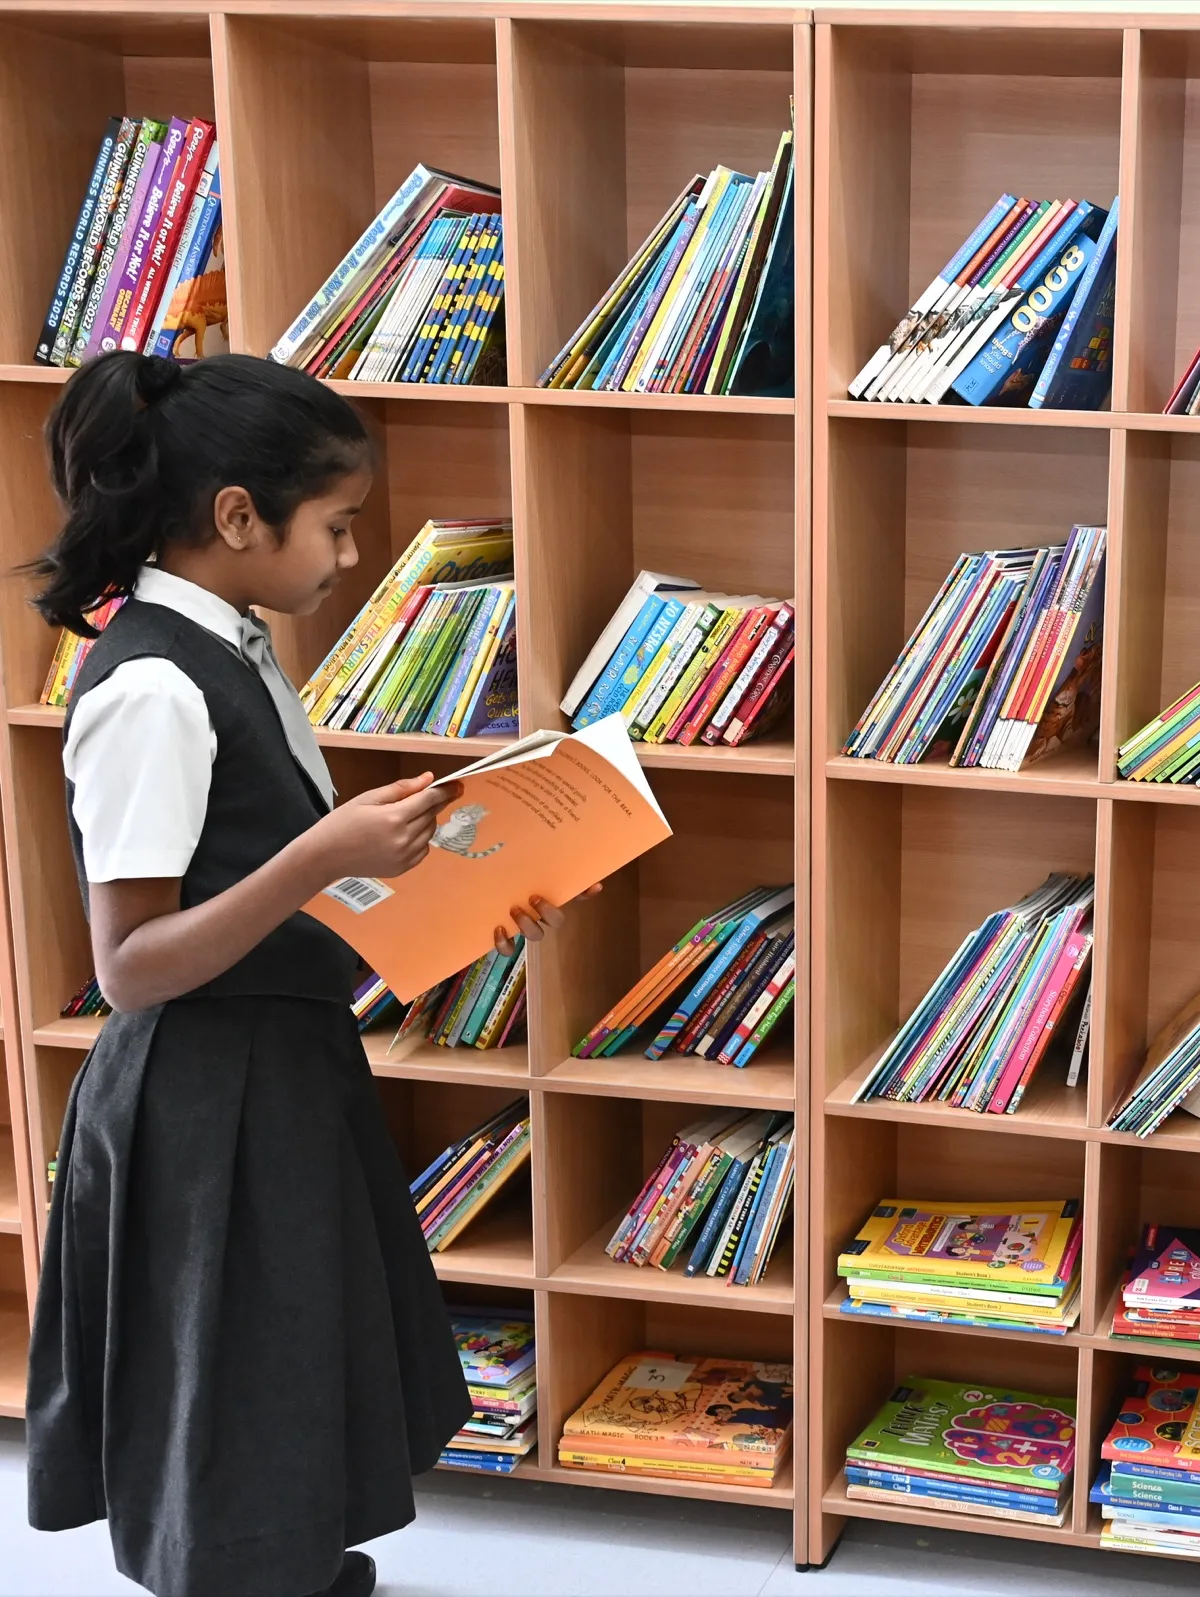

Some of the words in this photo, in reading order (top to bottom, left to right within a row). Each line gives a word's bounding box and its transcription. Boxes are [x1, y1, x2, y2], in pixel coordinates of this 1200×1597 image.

[87, 136, 113, 196] GUINNESS
[101, 141, 127, 200] GUINNESS
[119, 141, 147, 202] GUINNESS
[142, 185, 164, 228] Believe
[165, 179, 186, 218] Believe
[73, 197, 94, 242] WORLD
[87, 199, 109, 246] WORLD
[106, 201, 128, 245] WORLD
[161, 217, 174, 230] It
[181, 203, 200, 240] Science
[137, 227, 151, 240] It
[157, 228, 169, 241] or
[133, 239, 146, 253] or
[149, 240, 167, 266] Not!
[171, 238, 188, 270] Starter
[56, 241, 80, 297] RECORDS
[70, 245, 95, 301] RECORDS
[89, 245, 114, 301] RECORDS
[124, 253, 143, 281] Not!
[146, 266, 156, 279] ALL
[1085, 255, 1100, 277] Maths
[138, 280, 151, 304] WEIRD!
[1010, 243, 1087, 334] 8000
[1071, 275, 1091, 309] Dictionary
[46, 298, 63, 328] 2020
[62, 298, 79, 328] 2021
[107, 287, 126, 328] ORDINARY
[117, 288, 132, 317] ESCAPE
[134, 303, 144, 316] ALL
[81, 300, 98, 329] 2022
[113, 317, 123, 332] THE
[128, 316, 140, 336] TRUE!
[987, 345, 1003, 361] you
[988, 335, 1016, 359] things
[976, 357, 997, 375] know
[980, 351, 1003, 370] should
[397, 548, 434, 594] OXFORD
[377, 591, 404, 624] FIRST
[662, 599, 680, 618] JO
[666, 625, 681, 642] Bond
[335, 621, 383, 682] THESAURUS
[732, 923, 752, 944] Oxford
[769, 937, 784, 952] Kate
[721, 940, 739, 958] Study
[709, 954, 729, 975] Science
[750, 949, 777, 976] Hubbard
[689, 971, 717, 999] Dictionary
[1033, 988, 1057, 1026] Storybook
[1017, 1024, 1040, 1061] Collection
[497, 1134, 515, 1152] DON'T
[484, 1150, 500, 1166] WAKE
[463, 1174, 479, 1189] BABY
[475, 1164, 488, 1176] THE
[742, 1194, 753, 1207] YOUR
[737, 1206, 748, 1219] TURN
[675, 1226, 687, 1241] Helen
[733, 1219, 743, 1231] NOW
[1158, 1246, 1190, 1285] EUREKA
[963, 1390, 982, 1401] 2
[878, 1400, 925, 1439] THINK
[898, 1397, 953, 1449] MATHS!
[633, 1433, 654, 1442] BOOK
[620, 1457, 626, 1465] 4
[890, 1474, 905, 1483] Class
[904, 1474, 910, 1484] 3
[891, 1483, 905, 1491] Class
[905, 1484, 911, 1492] 3
[1131, 1481, 1163, 1492] Science
[1131, 1490, 1162, 1501] Science
[1116, 1510, 1135, 1518] SCIENCE
